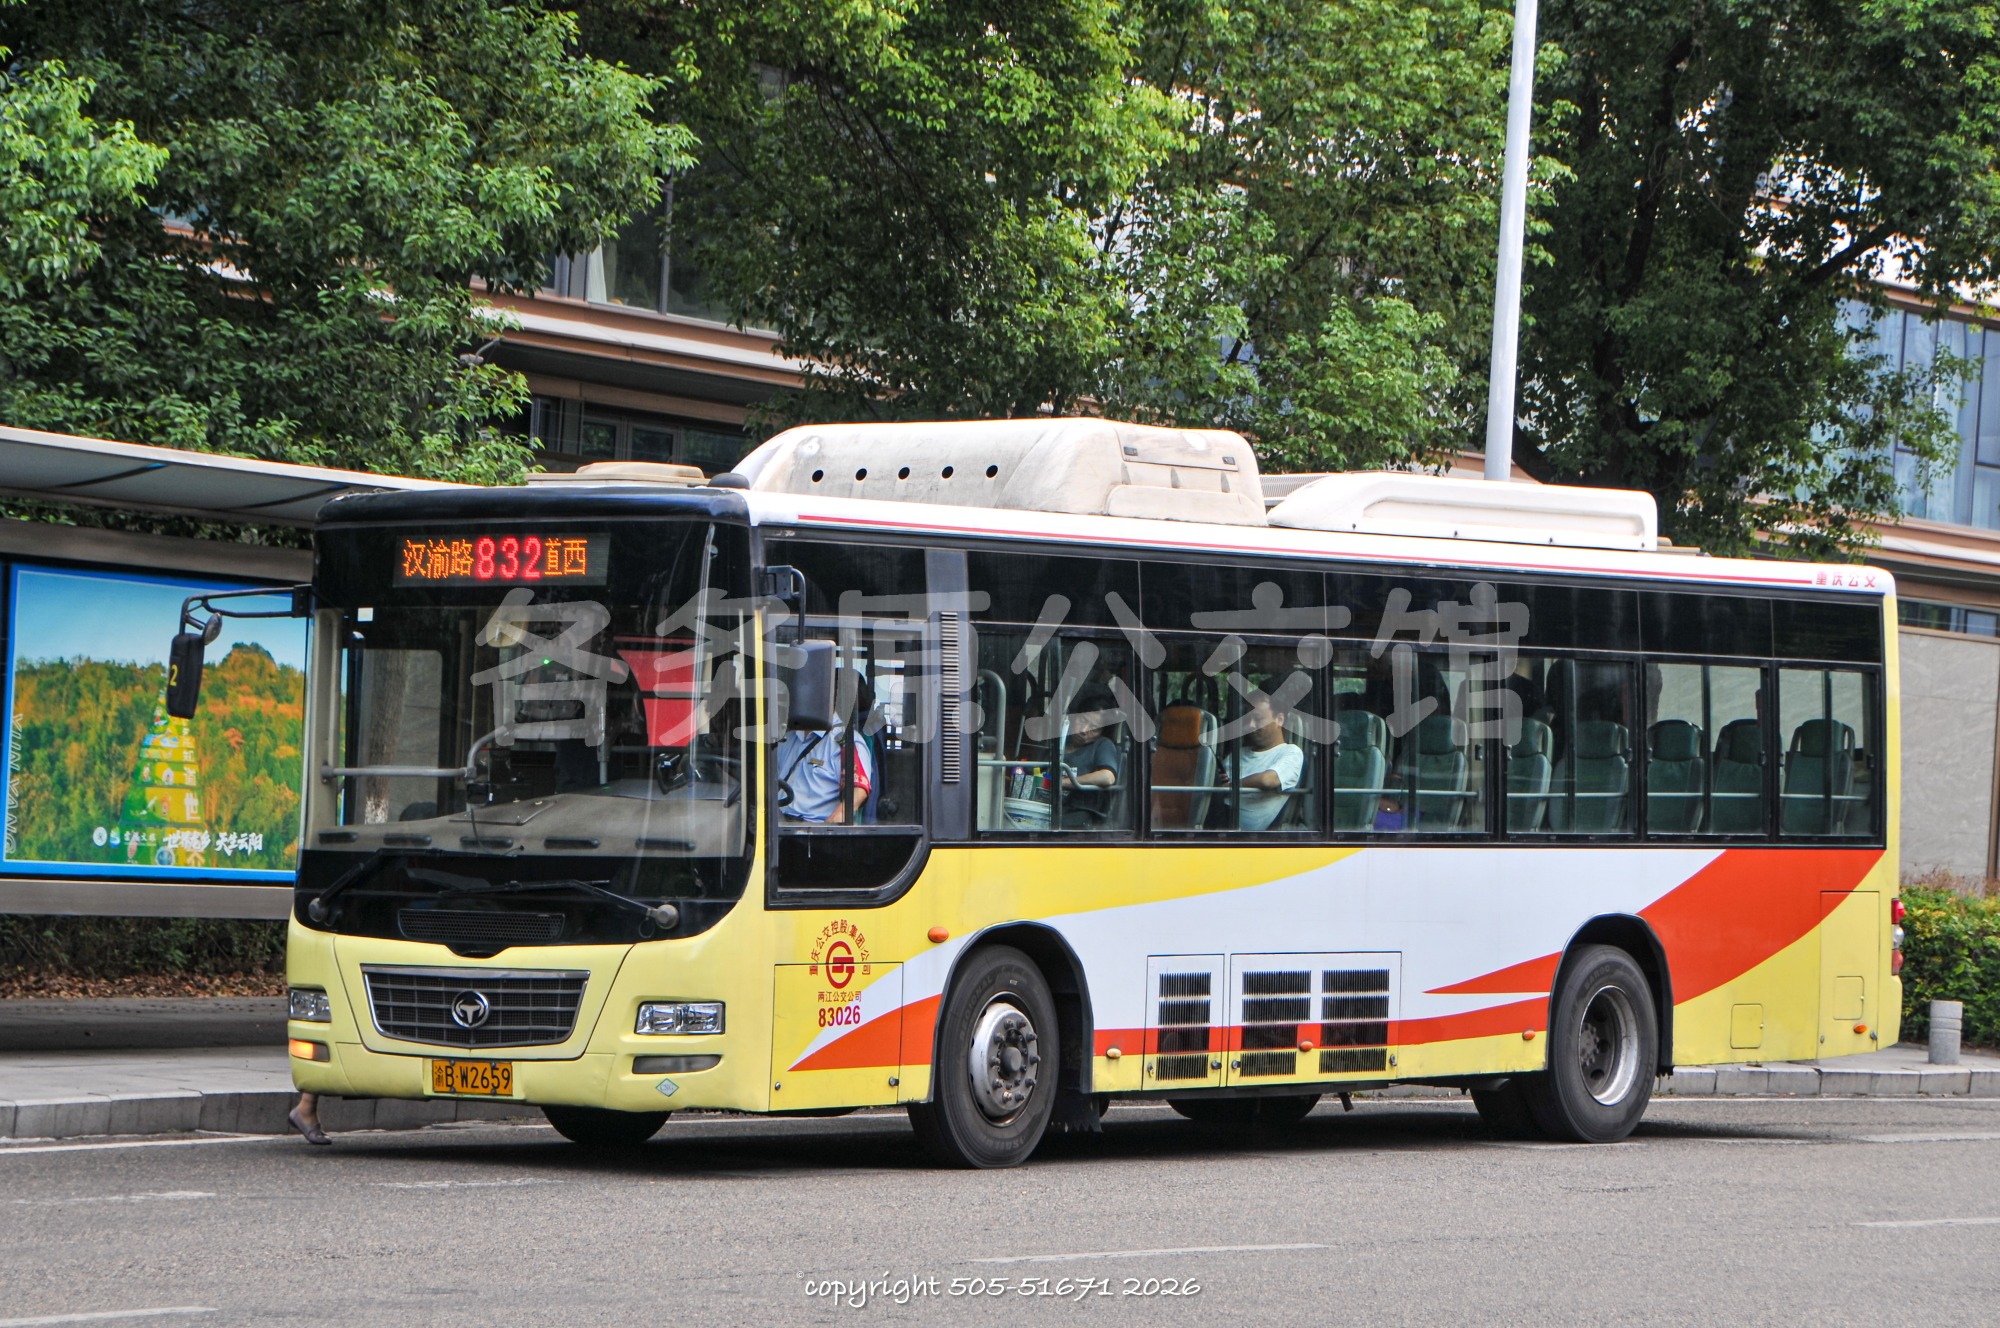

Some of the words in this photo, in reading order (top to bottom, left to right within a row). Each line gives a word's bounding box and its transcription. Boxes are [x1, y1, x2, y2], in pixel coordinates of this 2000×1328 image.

[403, 538, 474, 579] 汉渝路
[476, 536, 542, 578] 832
[1816, 571, 1876, 588] 重庆公交
[169, 664, 178, 687] 2
[817, 990, 862, 1003] 两江公交公司
[818, 1005, 861, 1027] 83026
